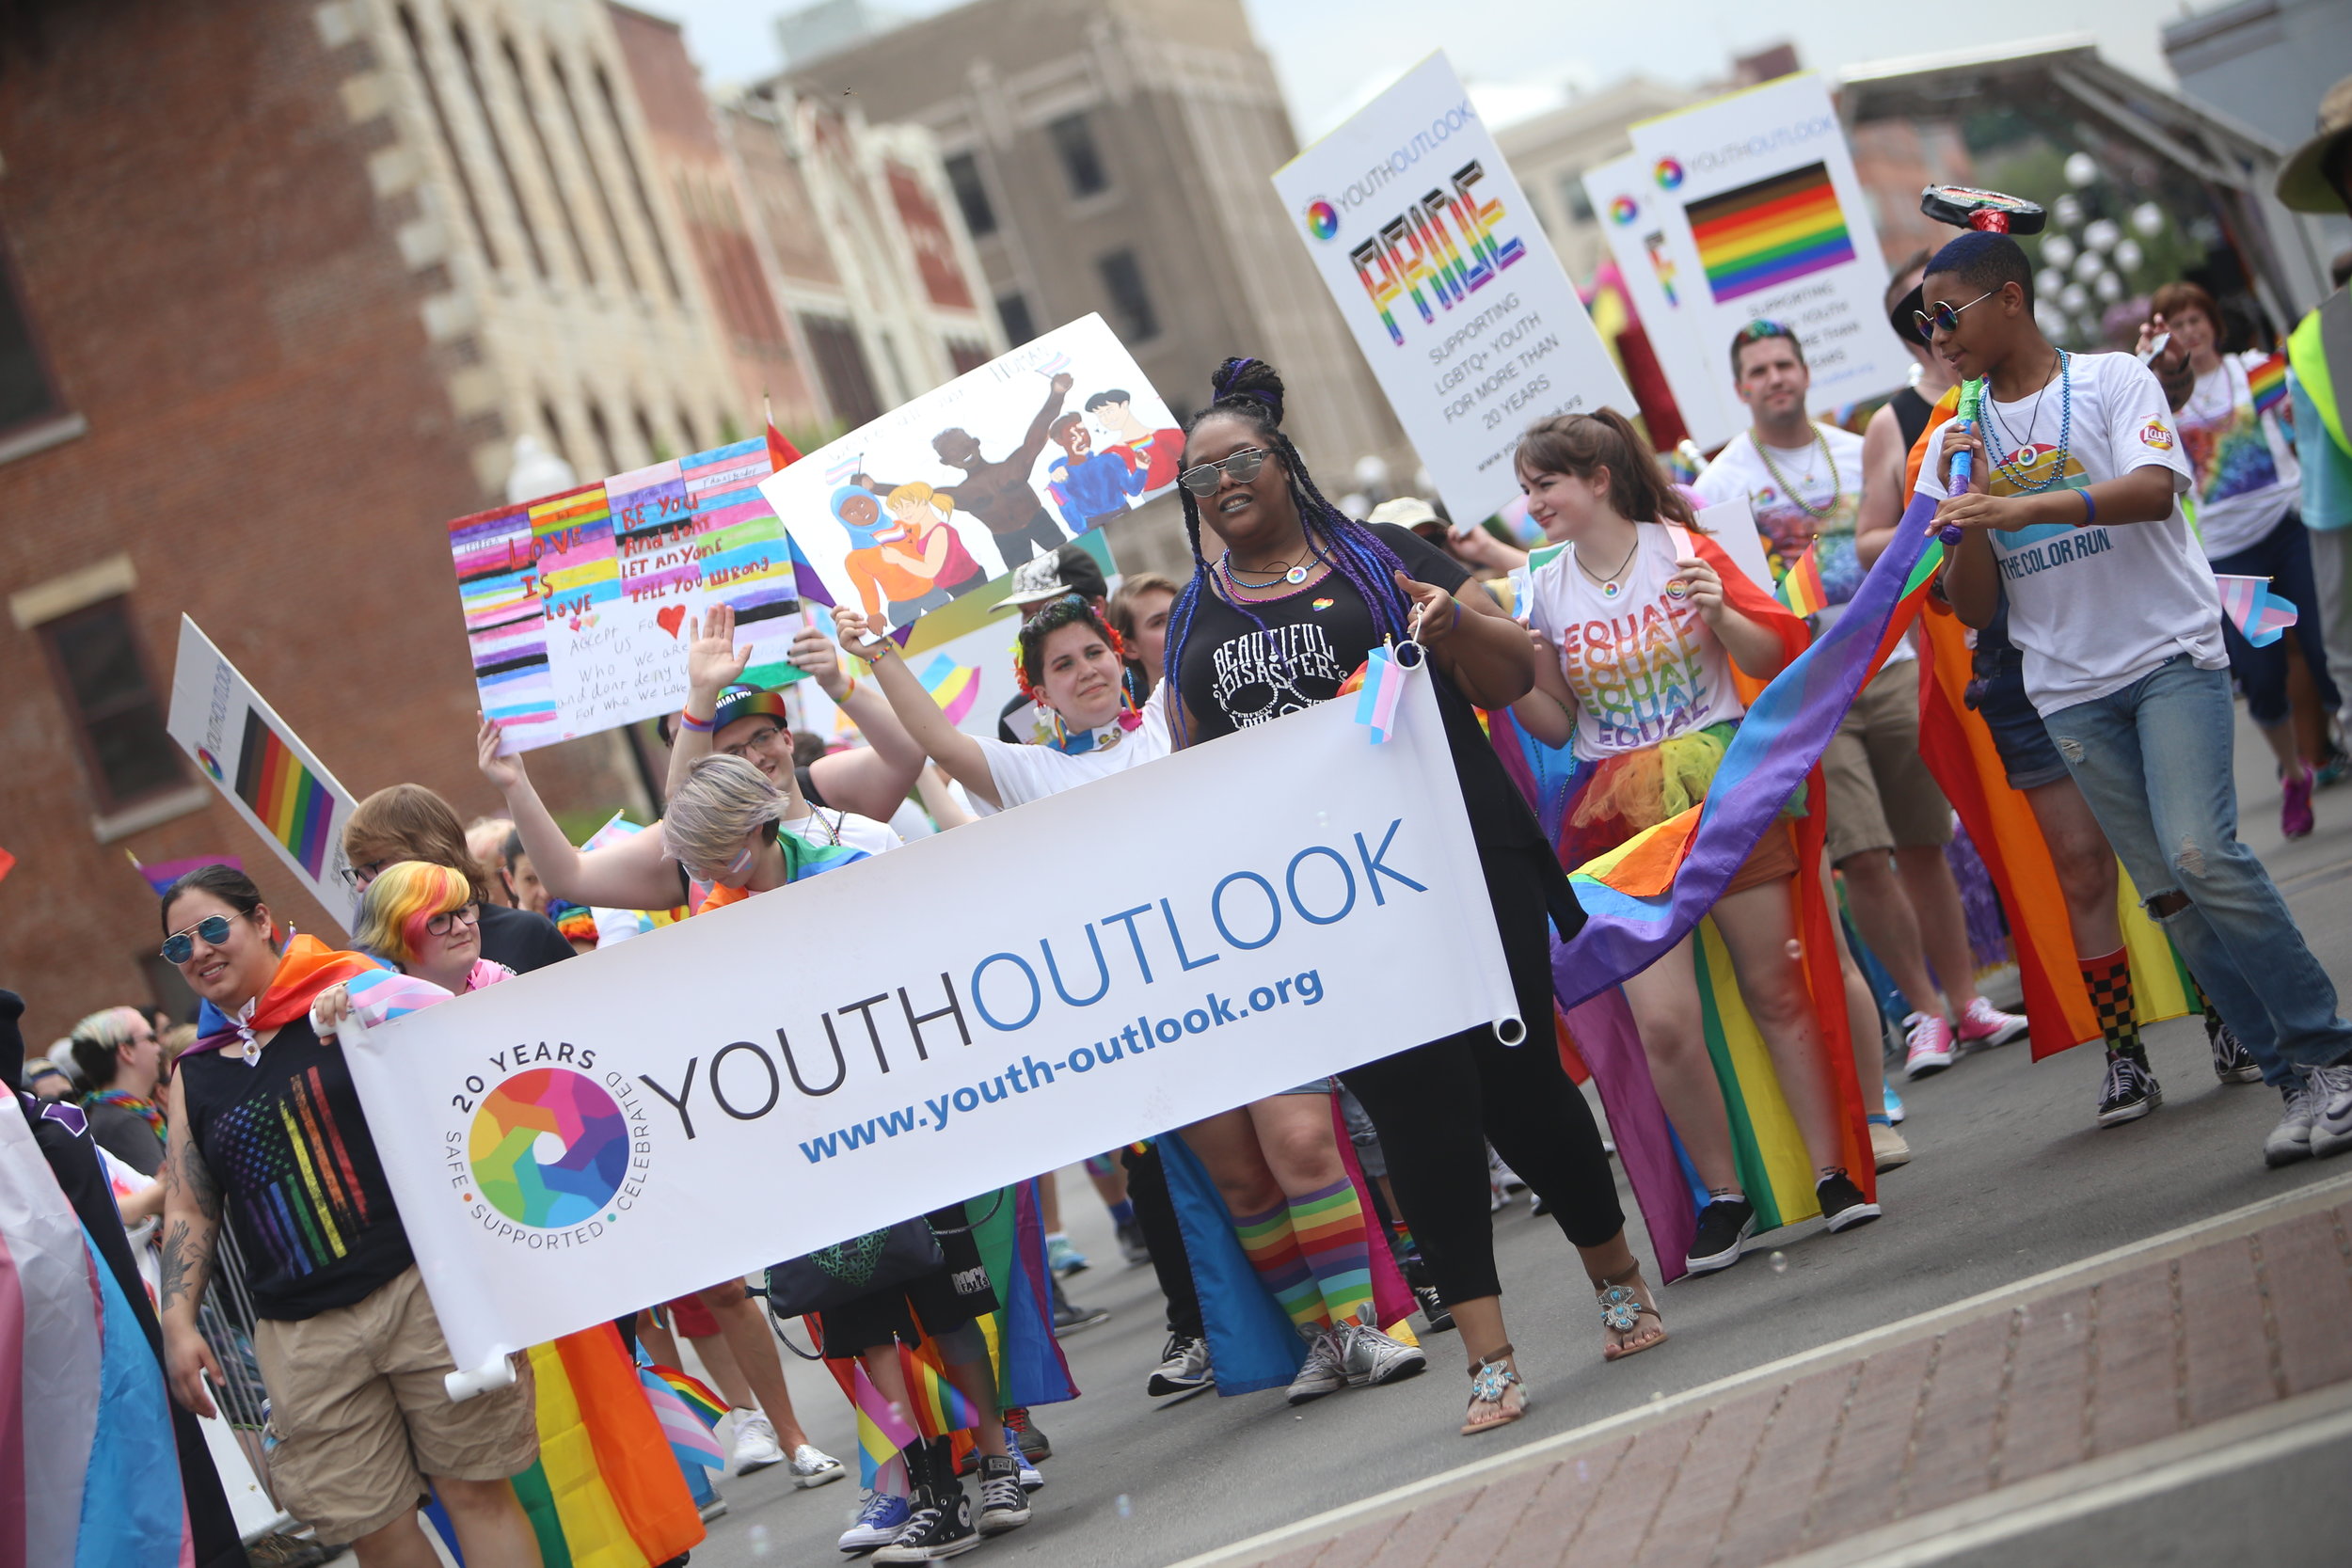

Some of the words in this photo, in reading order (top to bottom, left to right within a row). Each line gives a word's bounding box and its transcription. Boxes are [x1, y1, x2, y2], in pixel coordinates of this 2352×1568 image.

[1336, 99, 1476, 213] YOUTHOUTLOOK
[1348, 158, 1527, 347] PRIDE
[1428, 292, 1520, 365] SUPPORTING
[1435, 351, 1489, 396] LGBTQ+
[1490, 311, 1542, 355] YOUTH
[1443, 392, 1477, 423] FOR
[1474, 361, 1519, 400] MORE
[1518, 332, 1560, 369] THAN
[1482, 407, 1502, 430] 20
[1501, 373, 1550, 415] YEARS
[621, 502, 645, 531] BE
[508, 527, 583, 571] LOVE
[622, 559, 649, 579] LET
[1997, 555, 2025, 580] THE
[2020, 539, 2074, 576] COLOR
[520, 573, 553, 599] IS
[545, 594, 593, 621] LOVE
[629, 579, 666, 603] TELL
[1565, 594, 1687, 653] EQUAL
[1213, 623, 1335, 686] BEAUTIFUL
[1595, 698, 1709, 747] EQUAL
[638, 817, 1429, 1141] YOUTHOUTLOOK
[452, 1074, 485, 1114] 20
[489, 1041, 596, 1072] YEARS
[798, 969, 1325, 1164] www.youth-outlook.org
[446, 1130, 469, 1190] SAFE
[605, 1070, 651, 1212] CELEBRATED
[470, 1204, 604, 1250] SUPPORTED
